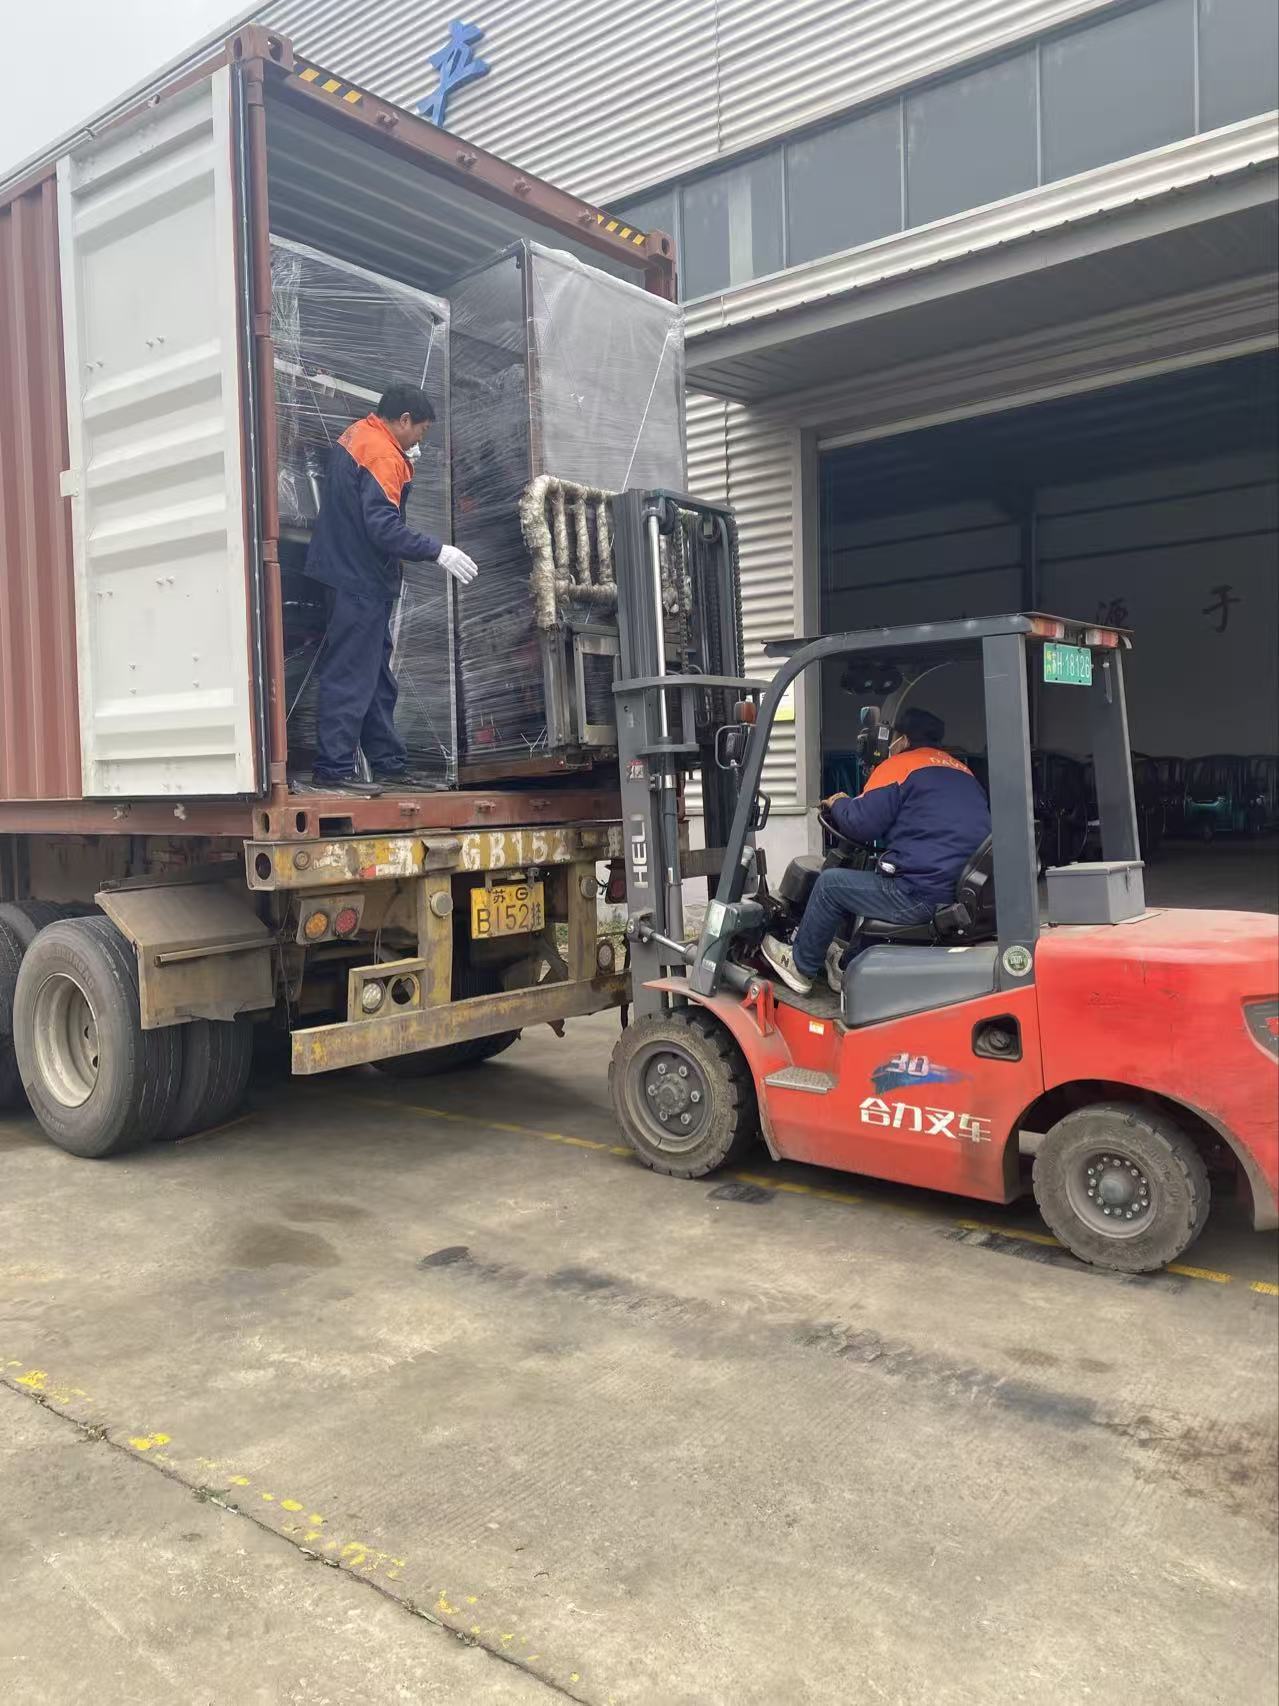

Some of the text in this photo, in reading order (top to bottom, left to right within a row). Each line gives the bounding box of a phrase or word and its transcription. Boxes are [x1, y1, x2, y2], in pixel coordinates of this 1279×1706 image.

[629, 813, 649, 889] HELI
[477, 901, 542, 935] B152挂
[859, 1097, 992, 1142] 合力叉车
